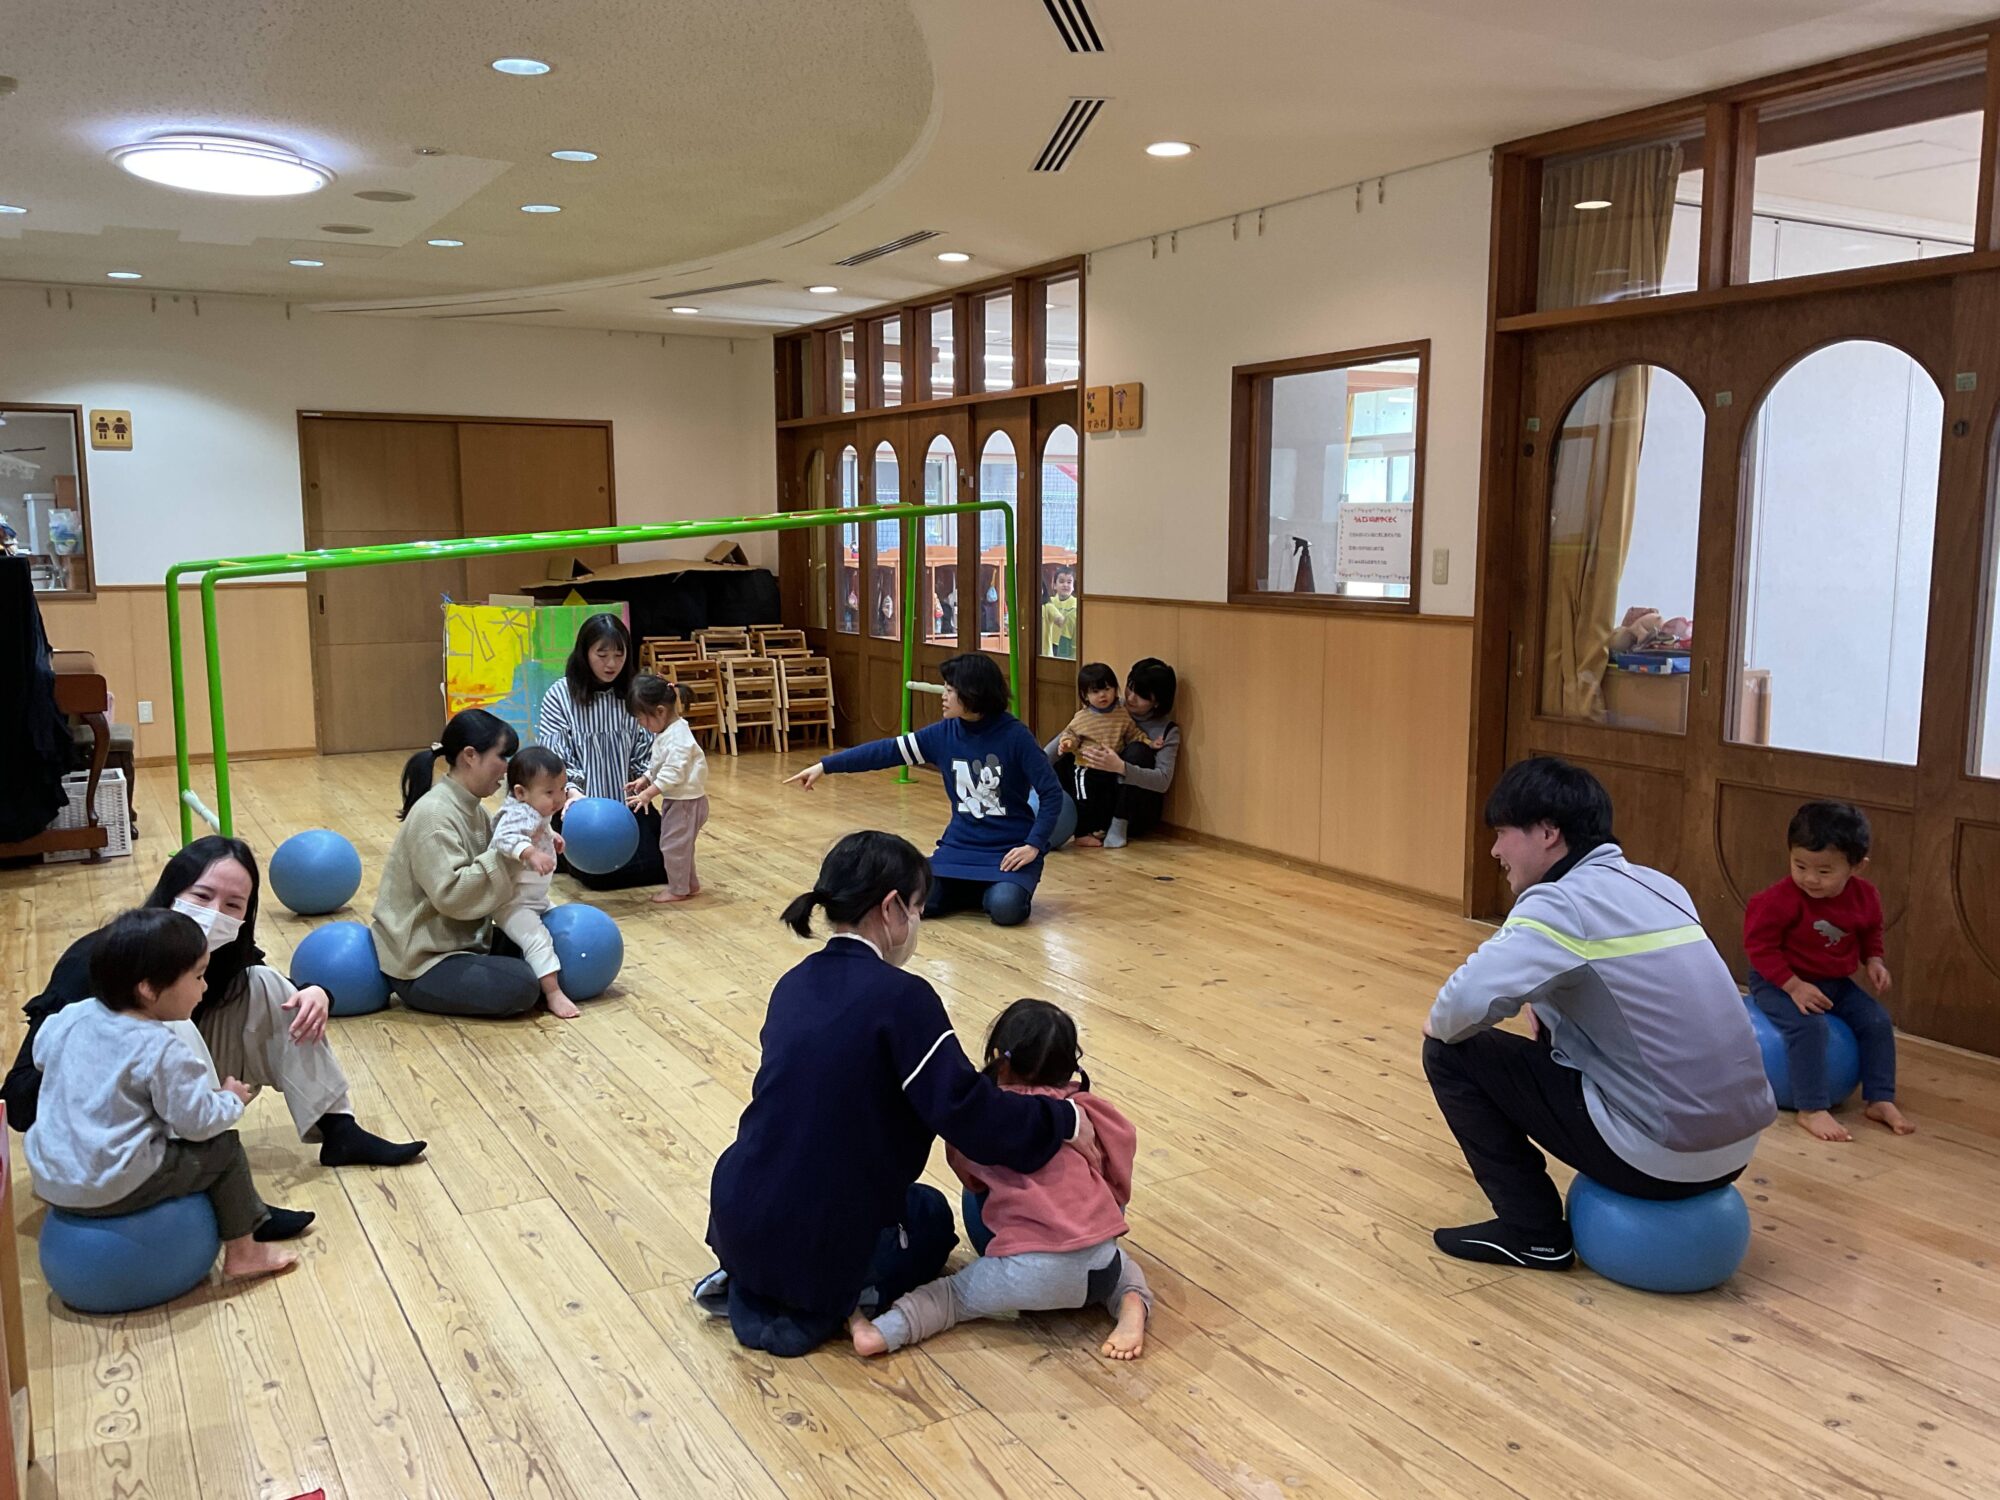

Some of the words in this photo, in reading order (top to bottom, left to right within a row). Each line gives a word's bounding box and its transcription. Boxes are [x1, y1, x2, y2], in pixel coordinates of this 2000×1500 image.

[1087, 418, 1106, 429] すみれ
[1117, 416, 1135, 428] ふじ
